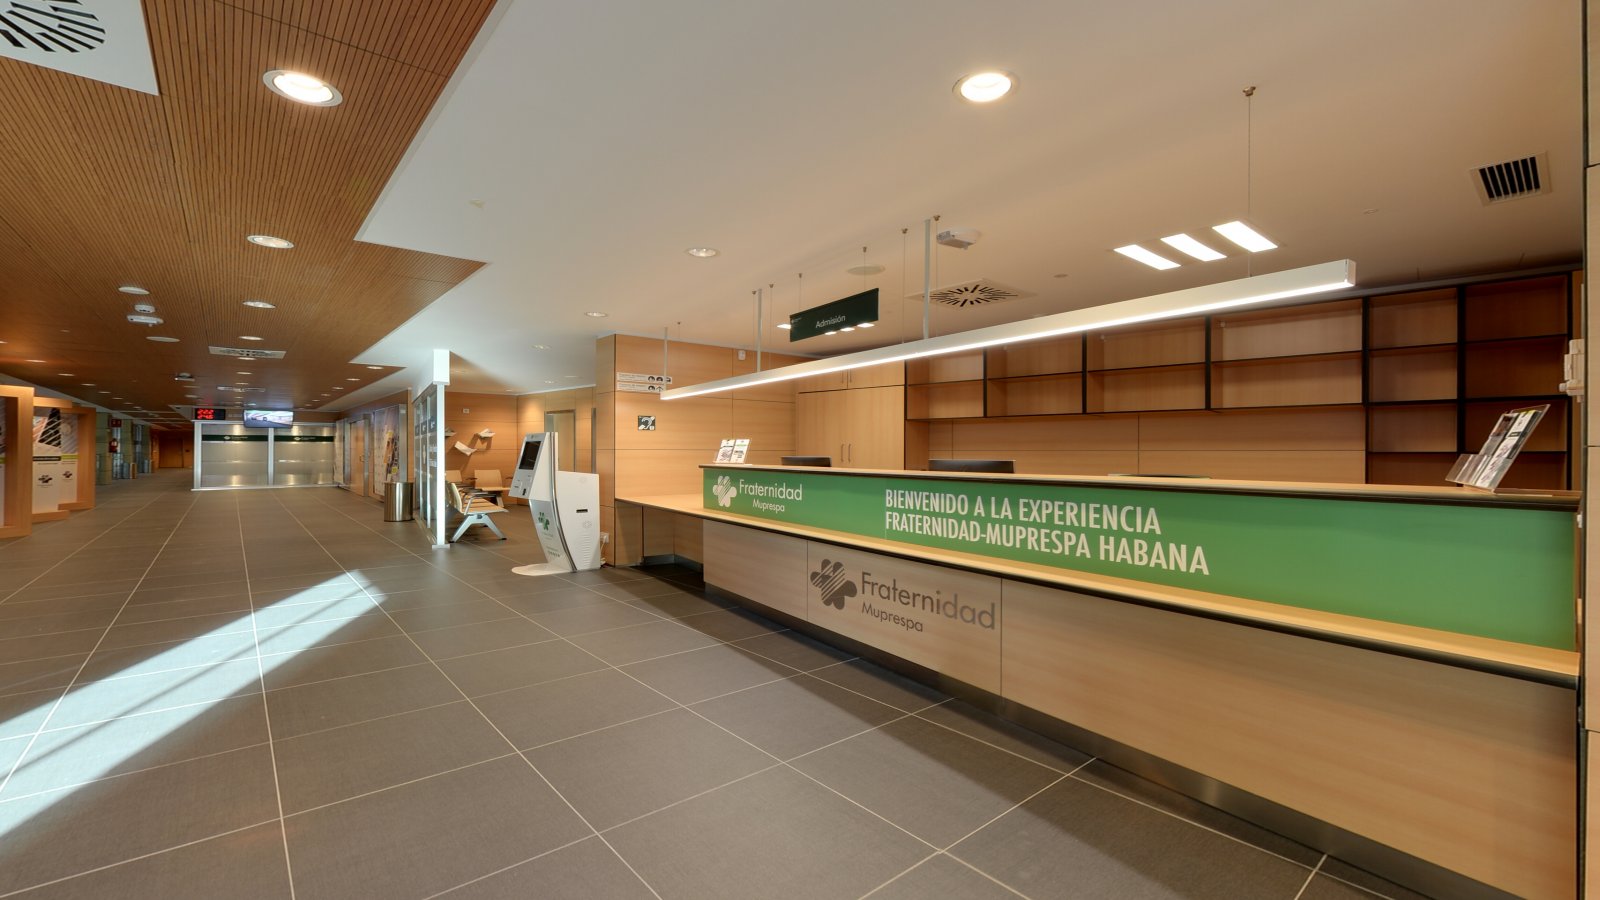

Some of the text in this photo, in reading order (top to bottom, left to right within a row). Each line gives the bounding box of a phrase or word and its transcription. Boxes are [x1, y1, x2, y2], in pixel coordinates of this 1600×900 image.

[815, 315, 846, 329] Admisión
[739, 479, 803, 501] Fraternidad
[752, 498, 785, 514] Muprespa
[885, 489, 1162, 535] BIENVENIDO A LA EXPERIENCIA
[885, 511, 1210, 576] FRATERNIDAD-MUPRESPA HABANA
[861, 571, 996, 630] Fraternidad
[861, 602, 924, 633] Muprespa
